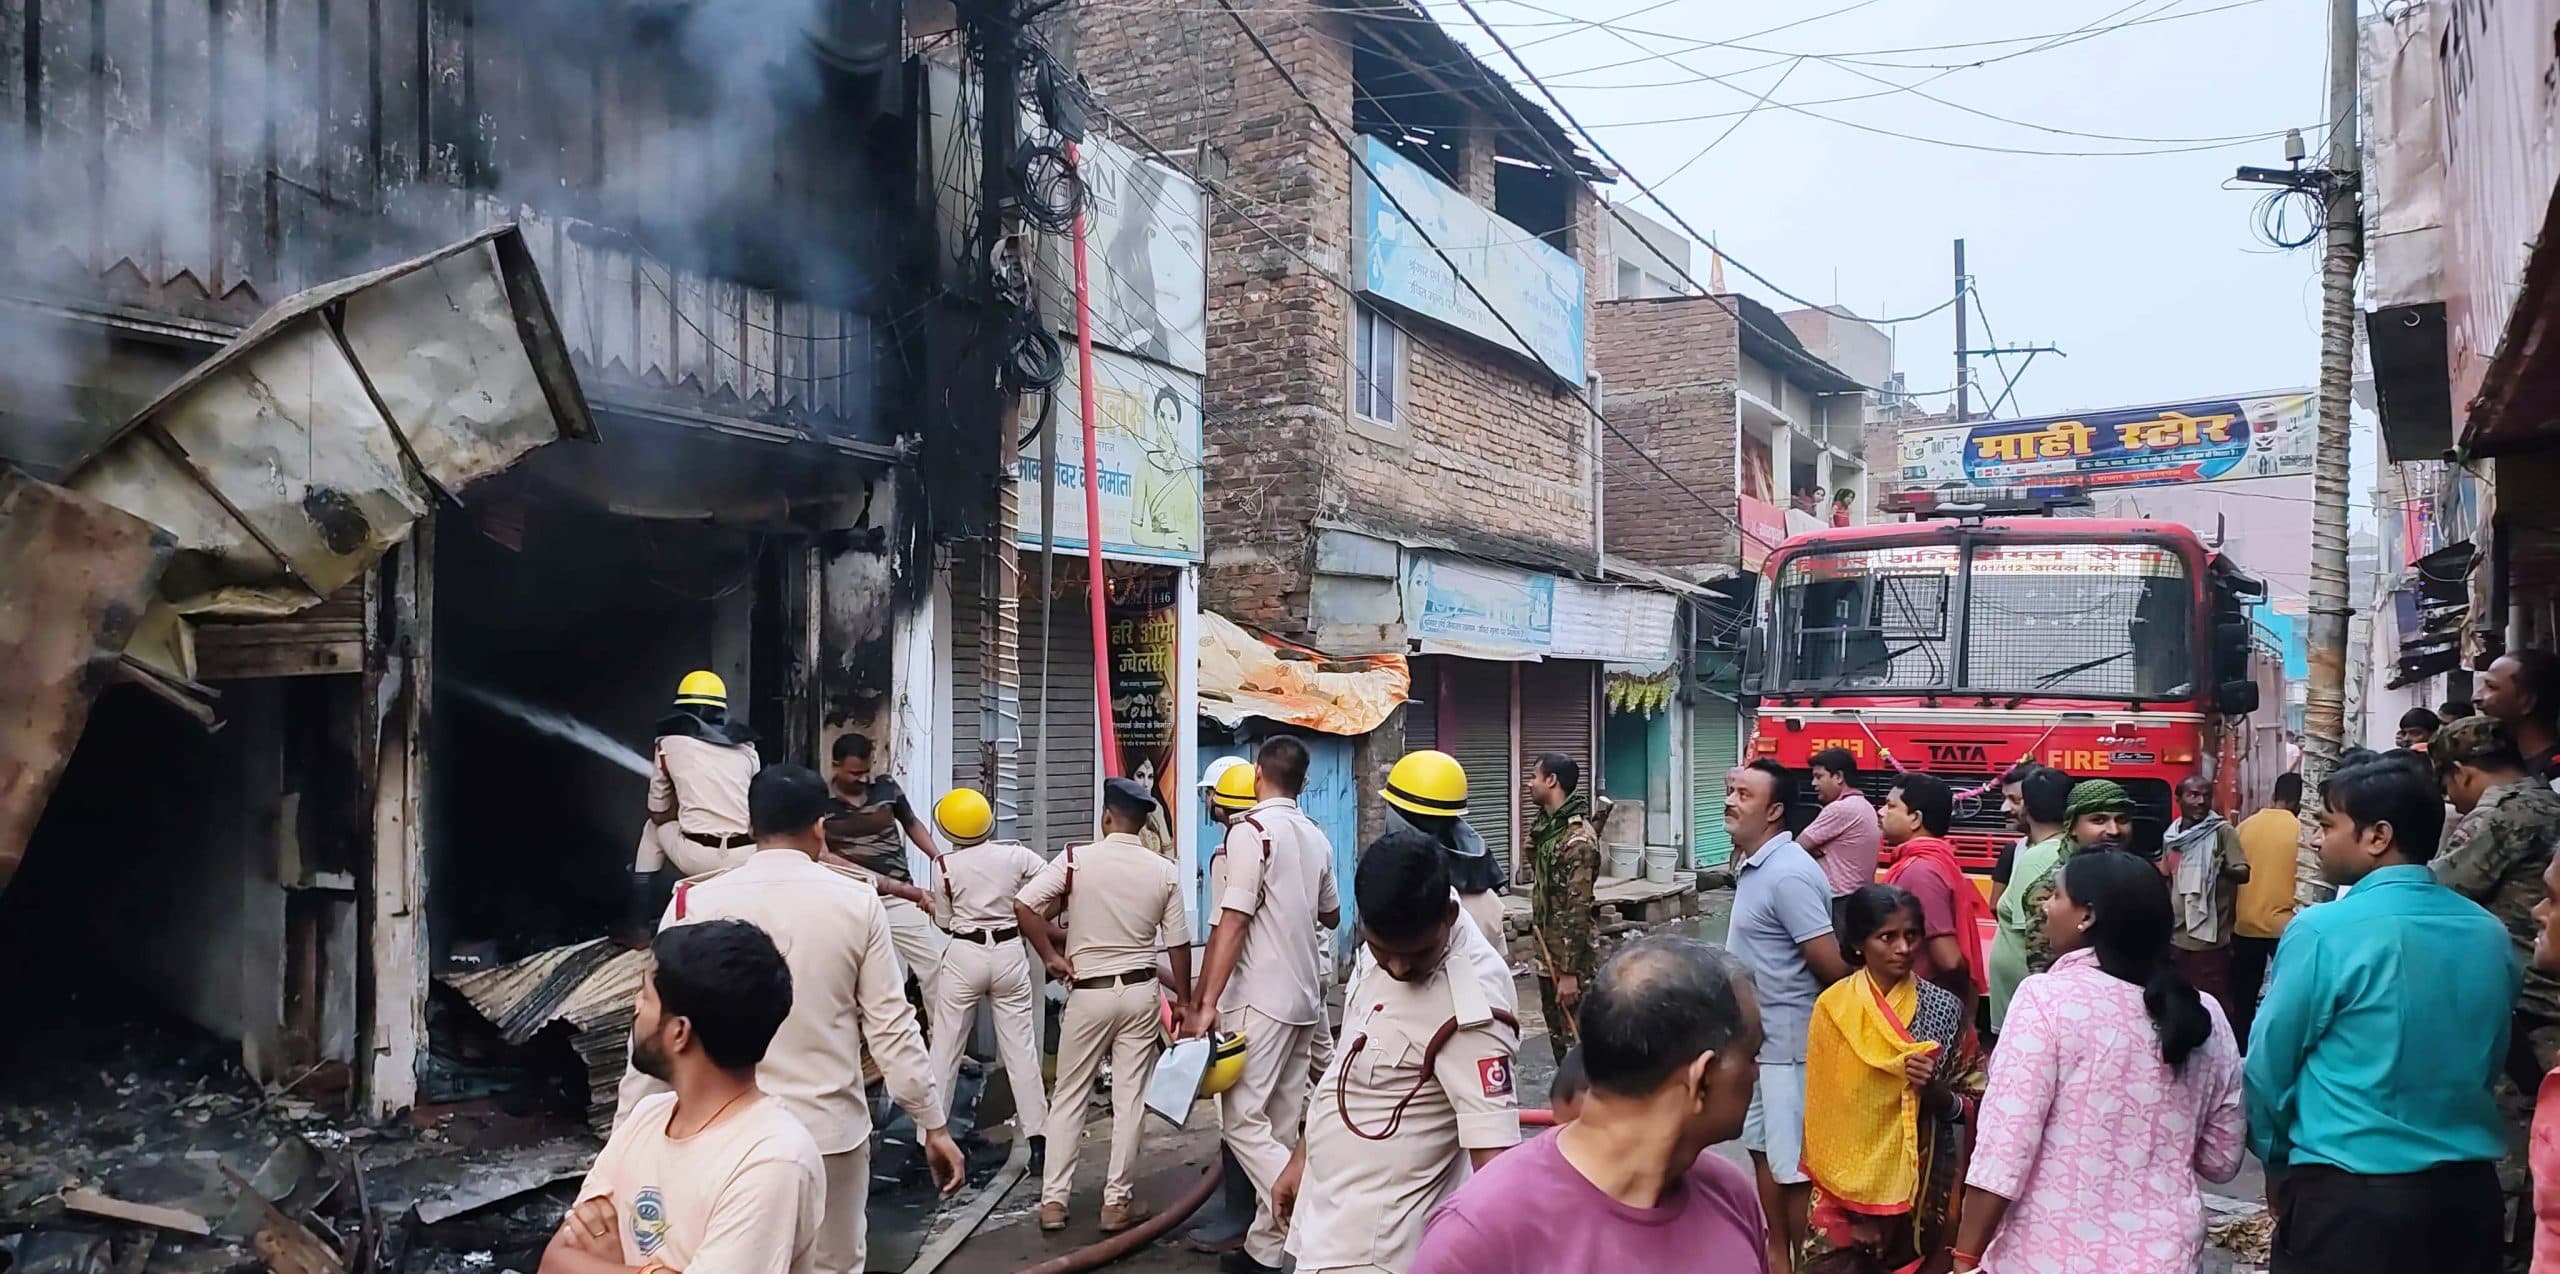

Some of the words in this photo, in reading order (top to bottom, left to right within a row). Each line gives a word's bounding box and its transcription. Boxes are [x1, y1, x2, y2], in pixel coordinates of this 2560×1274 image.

[1972, 421, 2096, 460] माही
[2114, 411, 2237, 449] स्टोर
[1112, 619, 1133, 645] हरि
[1118, 647, 1166, 673] ज्वेलर्स
[1928, 745, 1986, 760] TATA
[2047, 749, 2110, 770] FIRE
